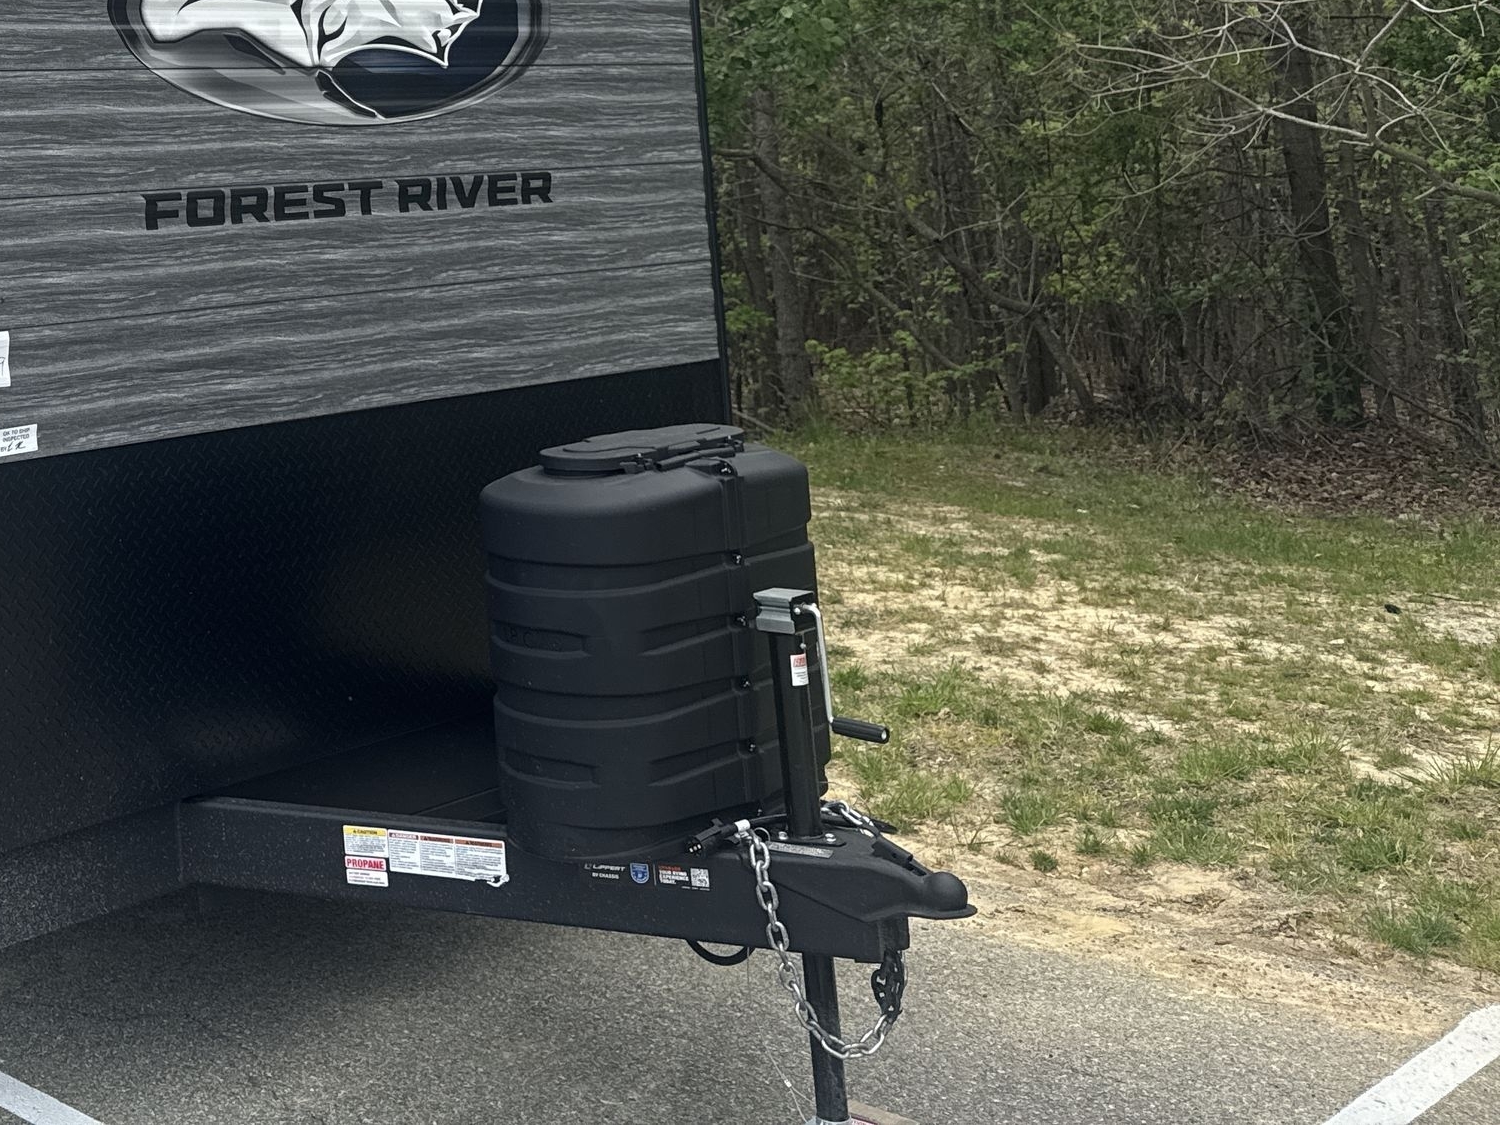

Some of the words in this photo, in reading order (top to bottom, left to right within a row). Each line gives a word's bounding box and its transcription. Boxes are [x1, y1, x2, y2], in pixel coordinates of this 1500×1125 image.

[140, 179, 383, 231] FOREST
[393, 171, 554, 213] RIVER
[346, 858, 385, 870] PROPANE
